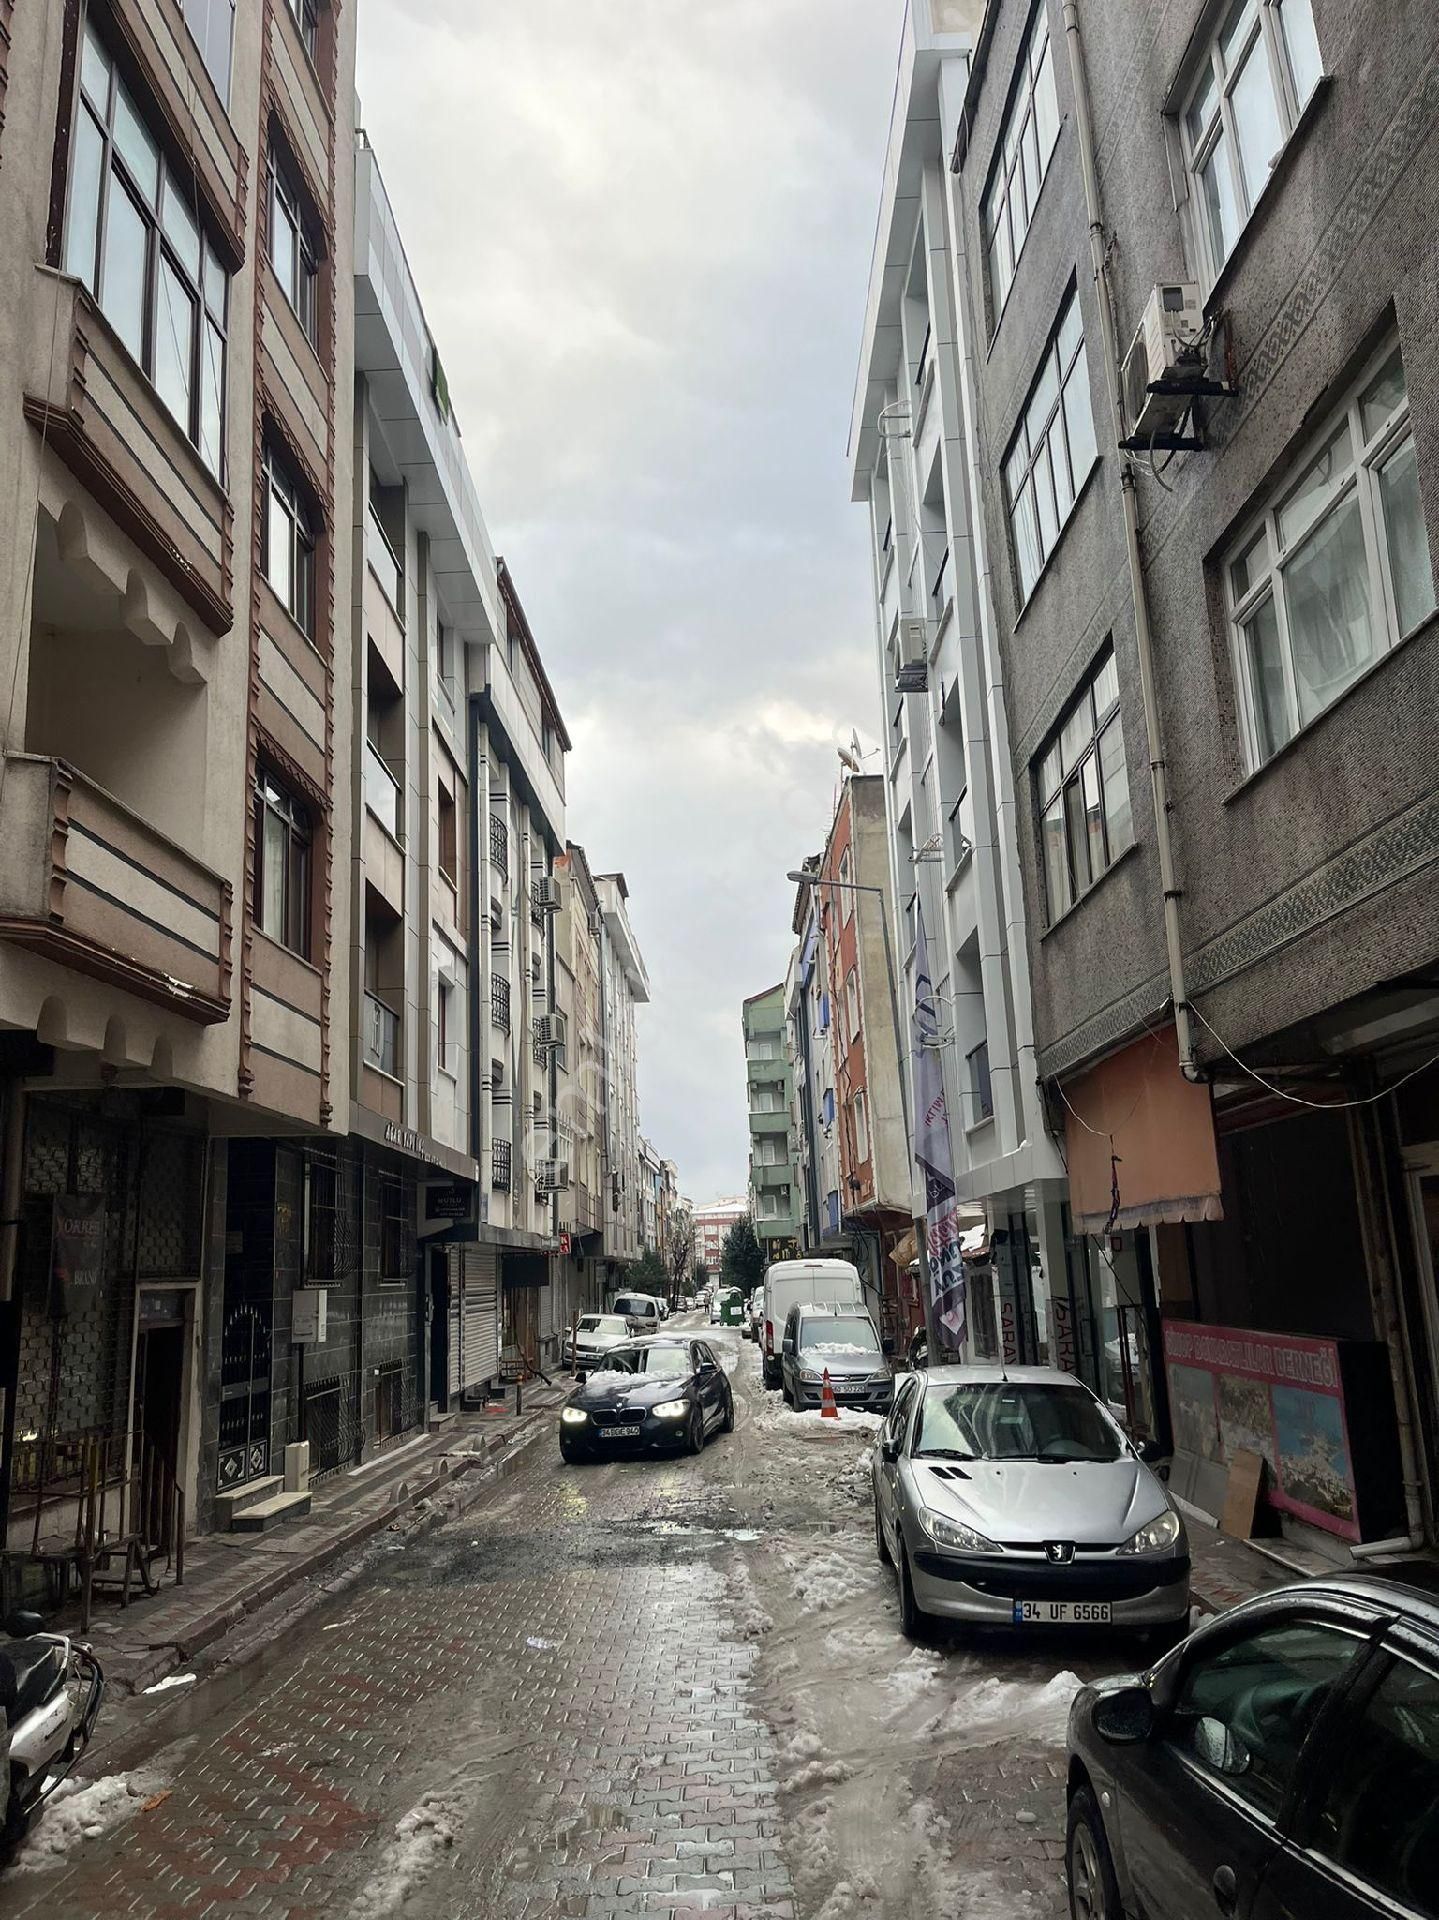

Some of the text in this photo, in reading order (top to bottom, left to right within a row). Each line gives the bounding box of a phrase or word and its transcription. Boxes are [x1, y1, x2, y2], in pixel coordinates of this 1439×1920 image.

[1023, 1603, 1108, 1620] 34 UF 6566
